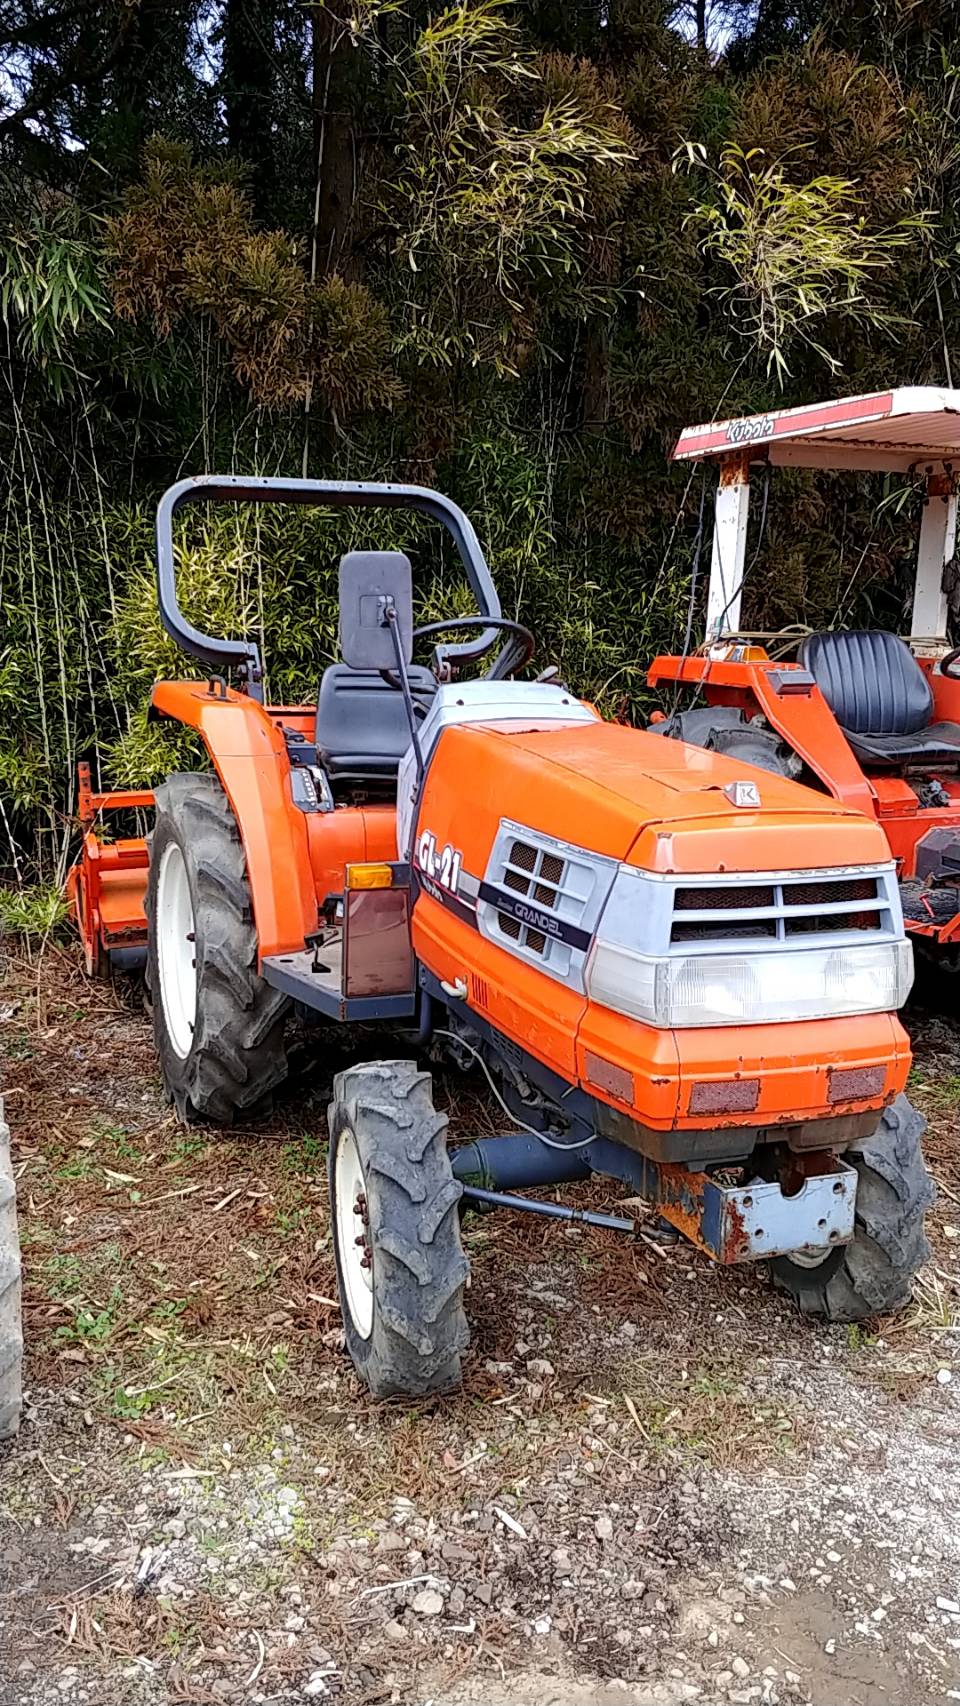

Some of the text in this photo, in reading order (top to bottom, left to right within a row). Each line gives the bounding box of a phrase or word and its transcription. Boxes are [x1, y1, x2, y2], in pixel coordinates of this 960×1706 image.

[728, 417, 775, 442] Kubota
[419, 830, 460, 893] GL-21
[515, 903, 563, 937] GRANDEL
